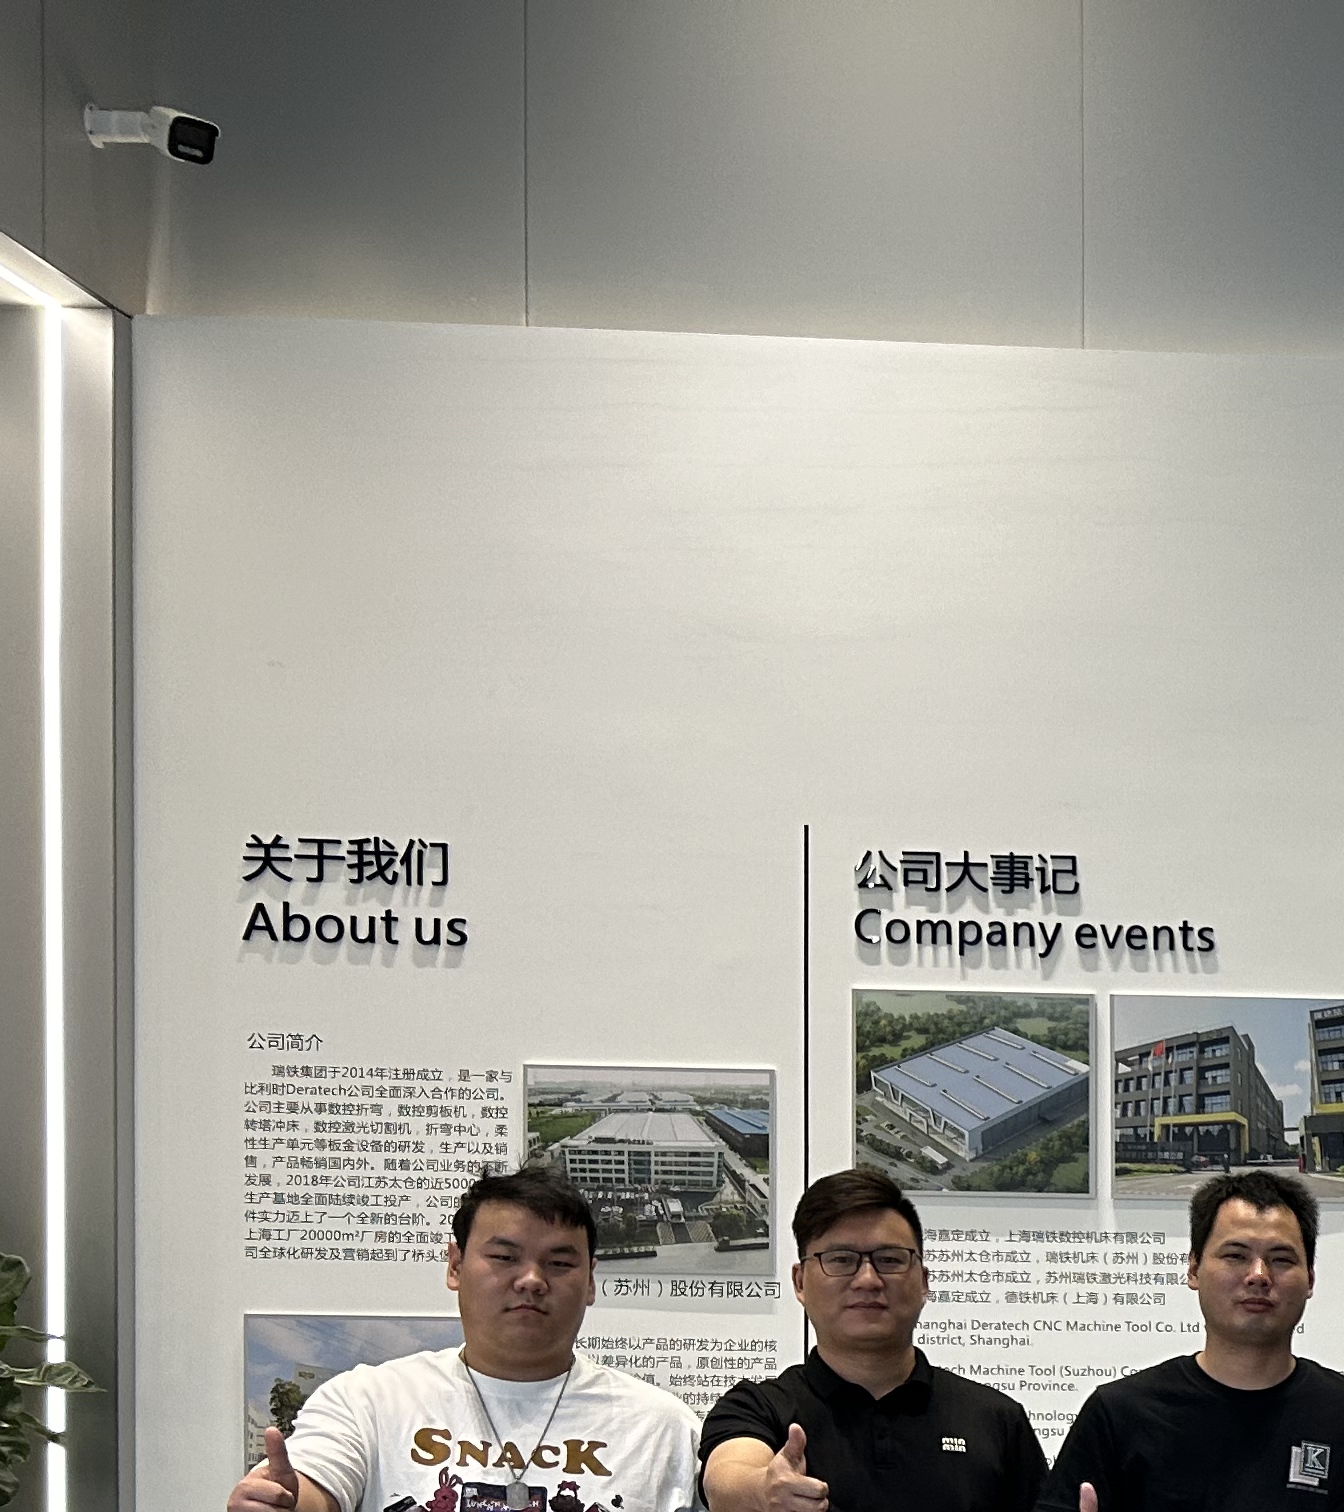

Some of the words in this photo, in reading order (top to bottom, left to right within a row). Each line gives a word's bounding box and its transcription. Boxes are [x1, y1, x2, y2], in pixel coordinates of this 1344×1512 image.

[242, 835, 449, 886] 关于我们
[855, 850, 1079, 895] 公司大事记
[242, 903, 399, 945] About
[414, 916, 468, 946] us
[854, 908, 1061, 957] Company
[1075, 920, 1215, 953] events
[247, 1033, 324, 1051] 公司简介
[918, 1334, 965, 1347] district,
[970, 1334, 1033, 1348] Shanghai.
[971, 1319, 1029, 1331] Deratech
[1034, 1321, 1062, 1332] CNC
[1066, 1321, 1121, 1332] Machine
[1126, 1320, 1151, 1332] Tool
[1155, 1322, 1176, 1333] Co.
[1181, 1321, 1200, 1333] Ltd
[970, 1365, 1025, 1377] Machine
[1029, 1365, 1056, 1377] Tool
[1060, 1365, 1117, 1379] (Suzhou)
[1019, 1380, 1078, 1393] Province.
[411, 1426, 612, 1477] SNACK
